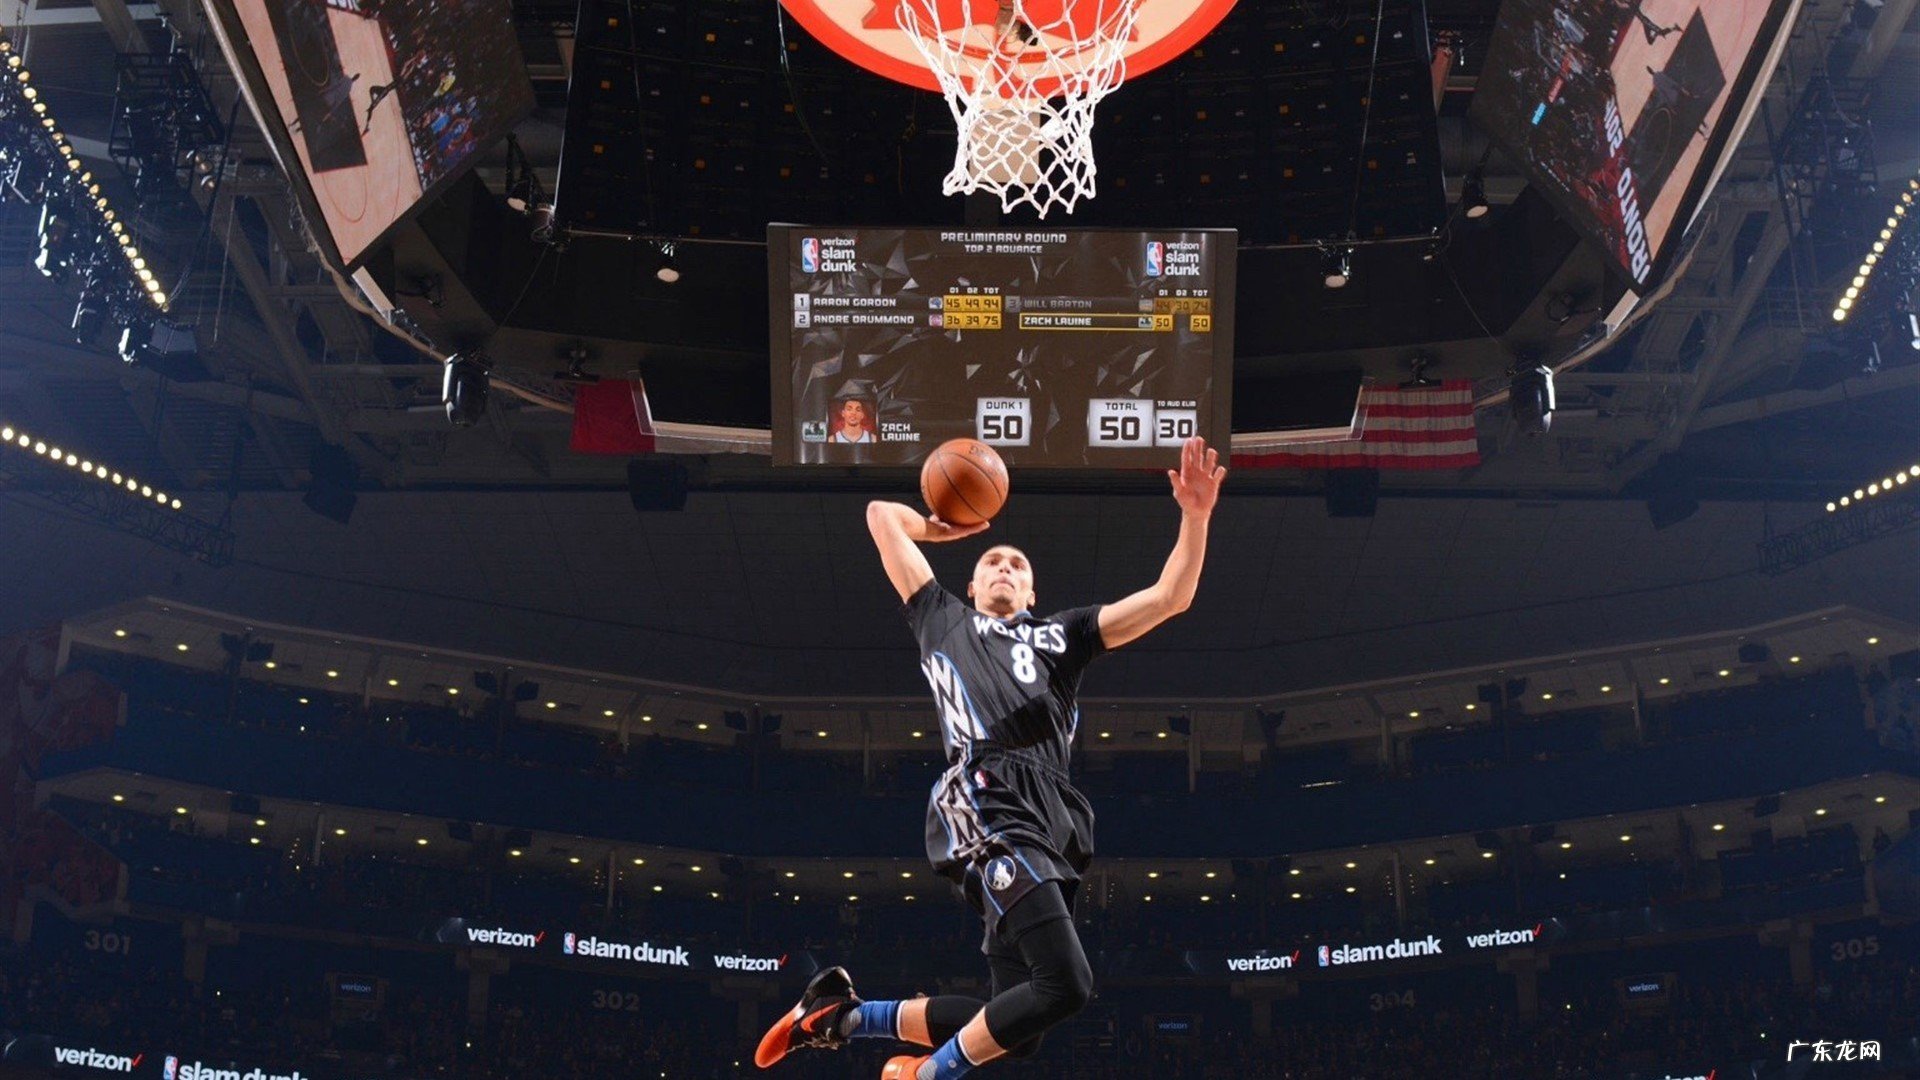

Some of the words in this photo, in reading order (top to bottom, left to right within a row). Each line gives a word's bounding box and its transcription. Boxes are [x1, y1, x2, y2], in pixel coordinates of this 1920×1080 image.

[821, 237, 855, 246] verizon
[941, 232, 1021, 242] PRELIMINARY
[1025, 233, 1067, 243] ROUND
[965, 244, 984, 253] TOP
[986, 245, 992, 253] 2
[1166, 241, 1199, 250] verizon
[821, 246, 855, 259] slam
[1165, 250, 1199, 263] slam
[821, 260, 857, 272] dunk
[1165, 263, 1200, 276] dunk
[813, 298, 850, 306] AARON
[853, 298, 896, 307] GORDON
[946, 299, 960, 308] 45
[965, 299, 979, 308] 49
[984, 299, 999, 308] 94
[1024, 300, 1047, 308] WILL
[1051, 300, 1092, 308] BARTON
[799, 315, 806, 324] 2
[814, 315, 849, 323] ANDRE
[852, 315, 915, 324] DRUMMOND
[966, 316, 979, 324] 39
[984, 316, 998, 324] 75
[1024, 317, 1052, 325] ZACH
[1156, 318, 1169, 327] 50
[1193, 318, 1208, 327] 50
[986, 401, 1015, 409] DUNK
[1018, 401, 1023, 409] 1
[1105, 402, 1138, 410] TOTAL
[881, 423, 911, 432] ZACH
[983, 415, 1023, 439] 50
[1100, 416, 1140, 441] 50
[1159, 418, 1193, 438] 30
[1011, 643, 1037, 683] 8
[85, 929, 131, 956] 301
[467, 927, 536, 948] verizon
[1467, 927, 1534, 948] verizon
[1830, 934, 1879, 961] 305
[713, 953, 778, 971] verizon
[1227, 953, 1292, 971] verizon
[341, 982, 371, 993] verizon
[592, 989, 640, 1012] 302
[54, 1046, 132, 1072] verizon
